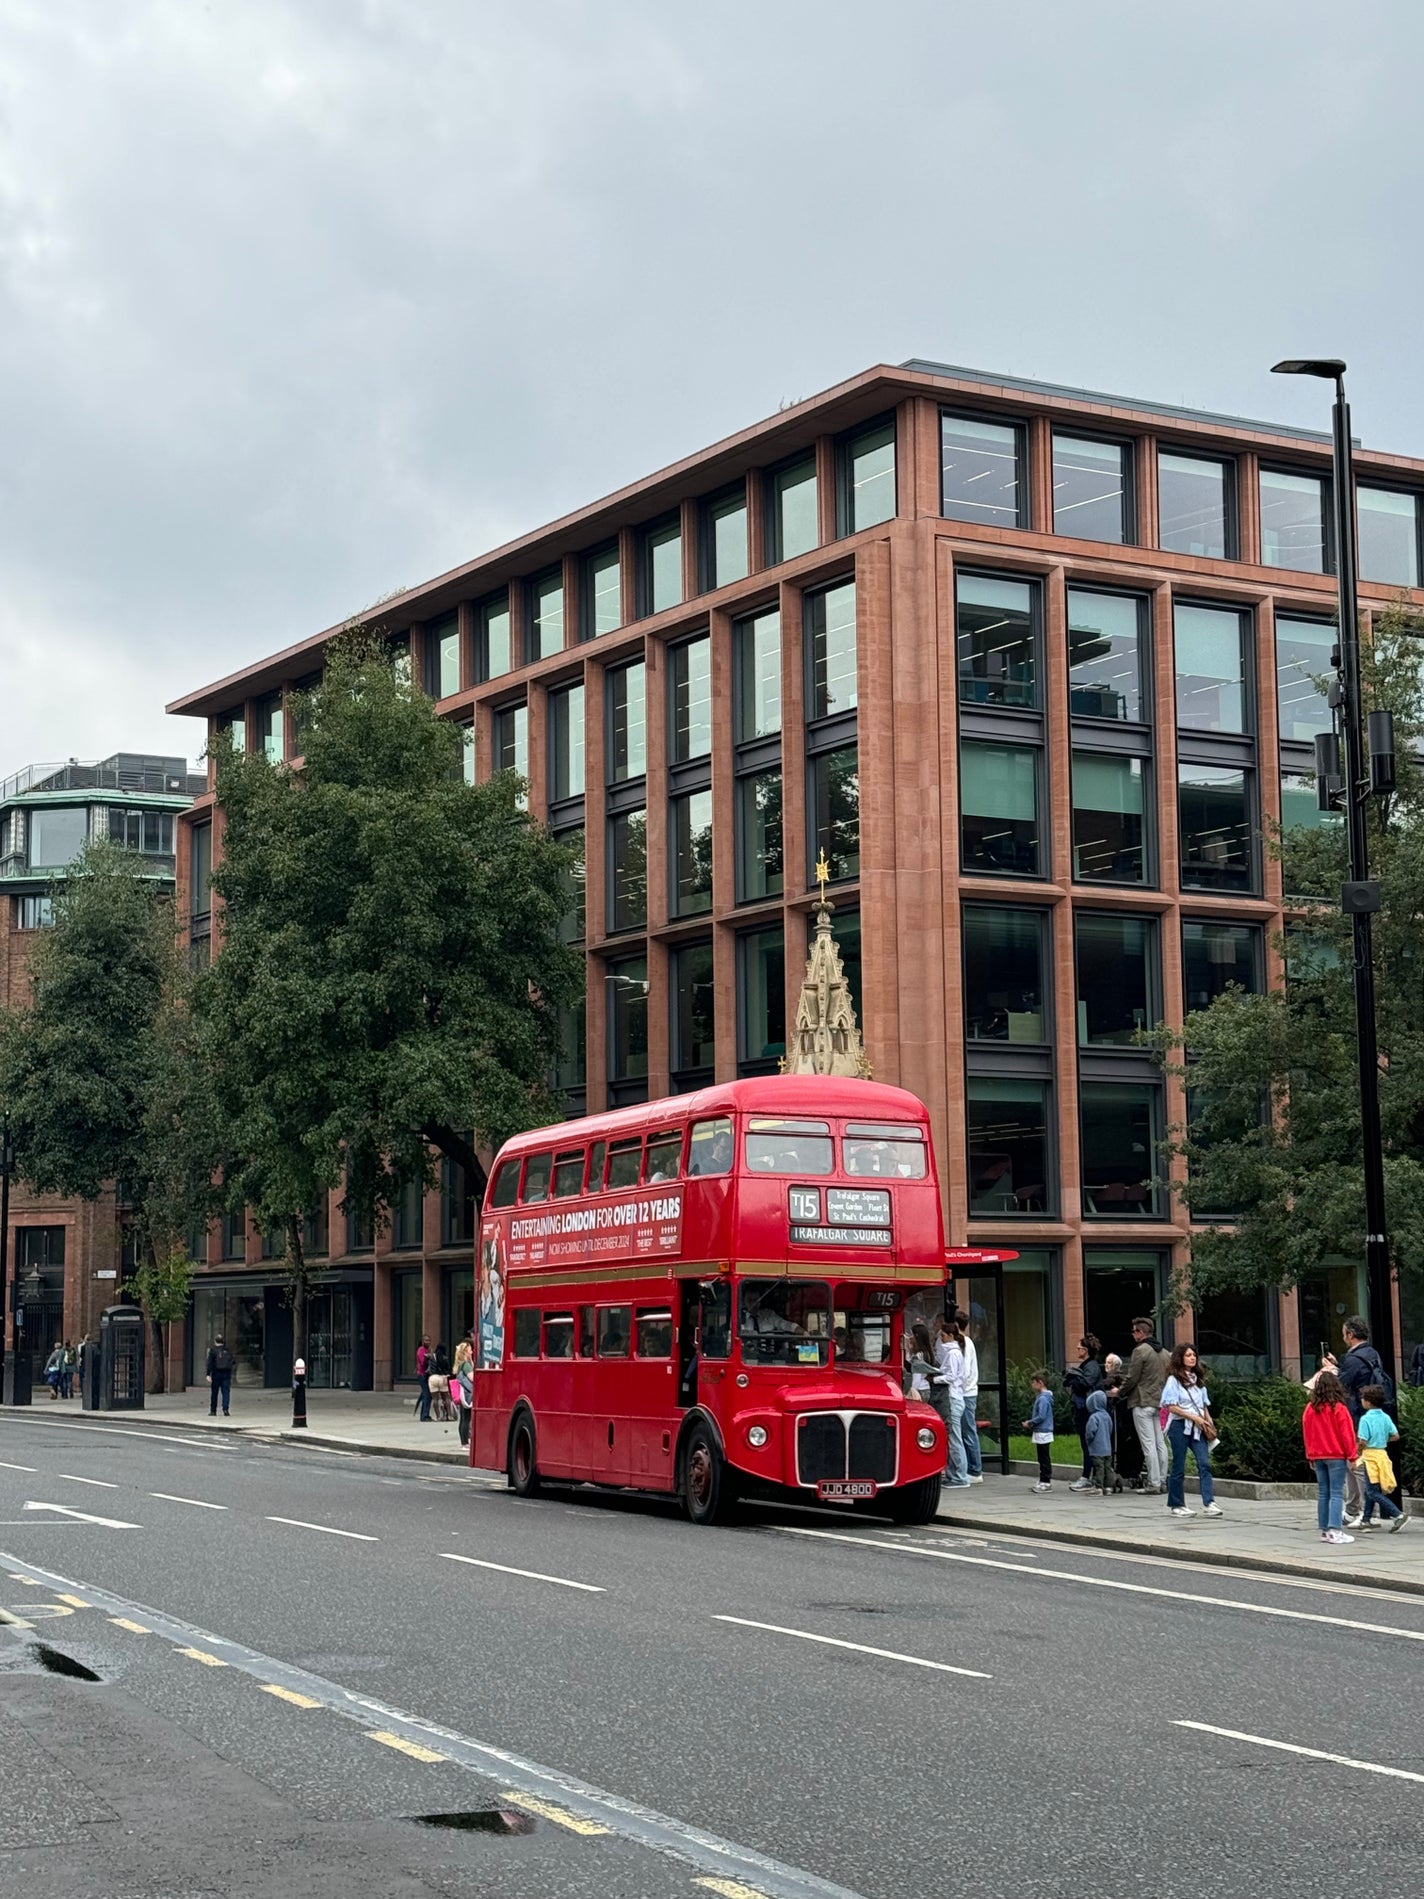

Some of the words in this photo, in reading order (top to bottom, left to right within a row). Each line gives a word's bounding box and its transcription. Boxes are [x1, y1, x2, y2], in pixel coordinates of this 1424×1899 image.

[836, 1191, 860, 1202] Trafalgar
[862, 1192, 880, 1202] Square
[511, 1214, 561, 1240] ENTERTAINING
[562, 1209, 596, 1233] LONDON
[597, 1207, 613, 1229] FOR
[613, 1203, 637, 1227] OVER
[638, 1201, 649, 1223] 12
[650, 1196, 680, 1221] YEARS
[859, 1213, 884, 1222] Cathedral
[794, 1227, 848, 1240] TRAFALGAR
[853, 1229, 889, 1242] SQUARE
